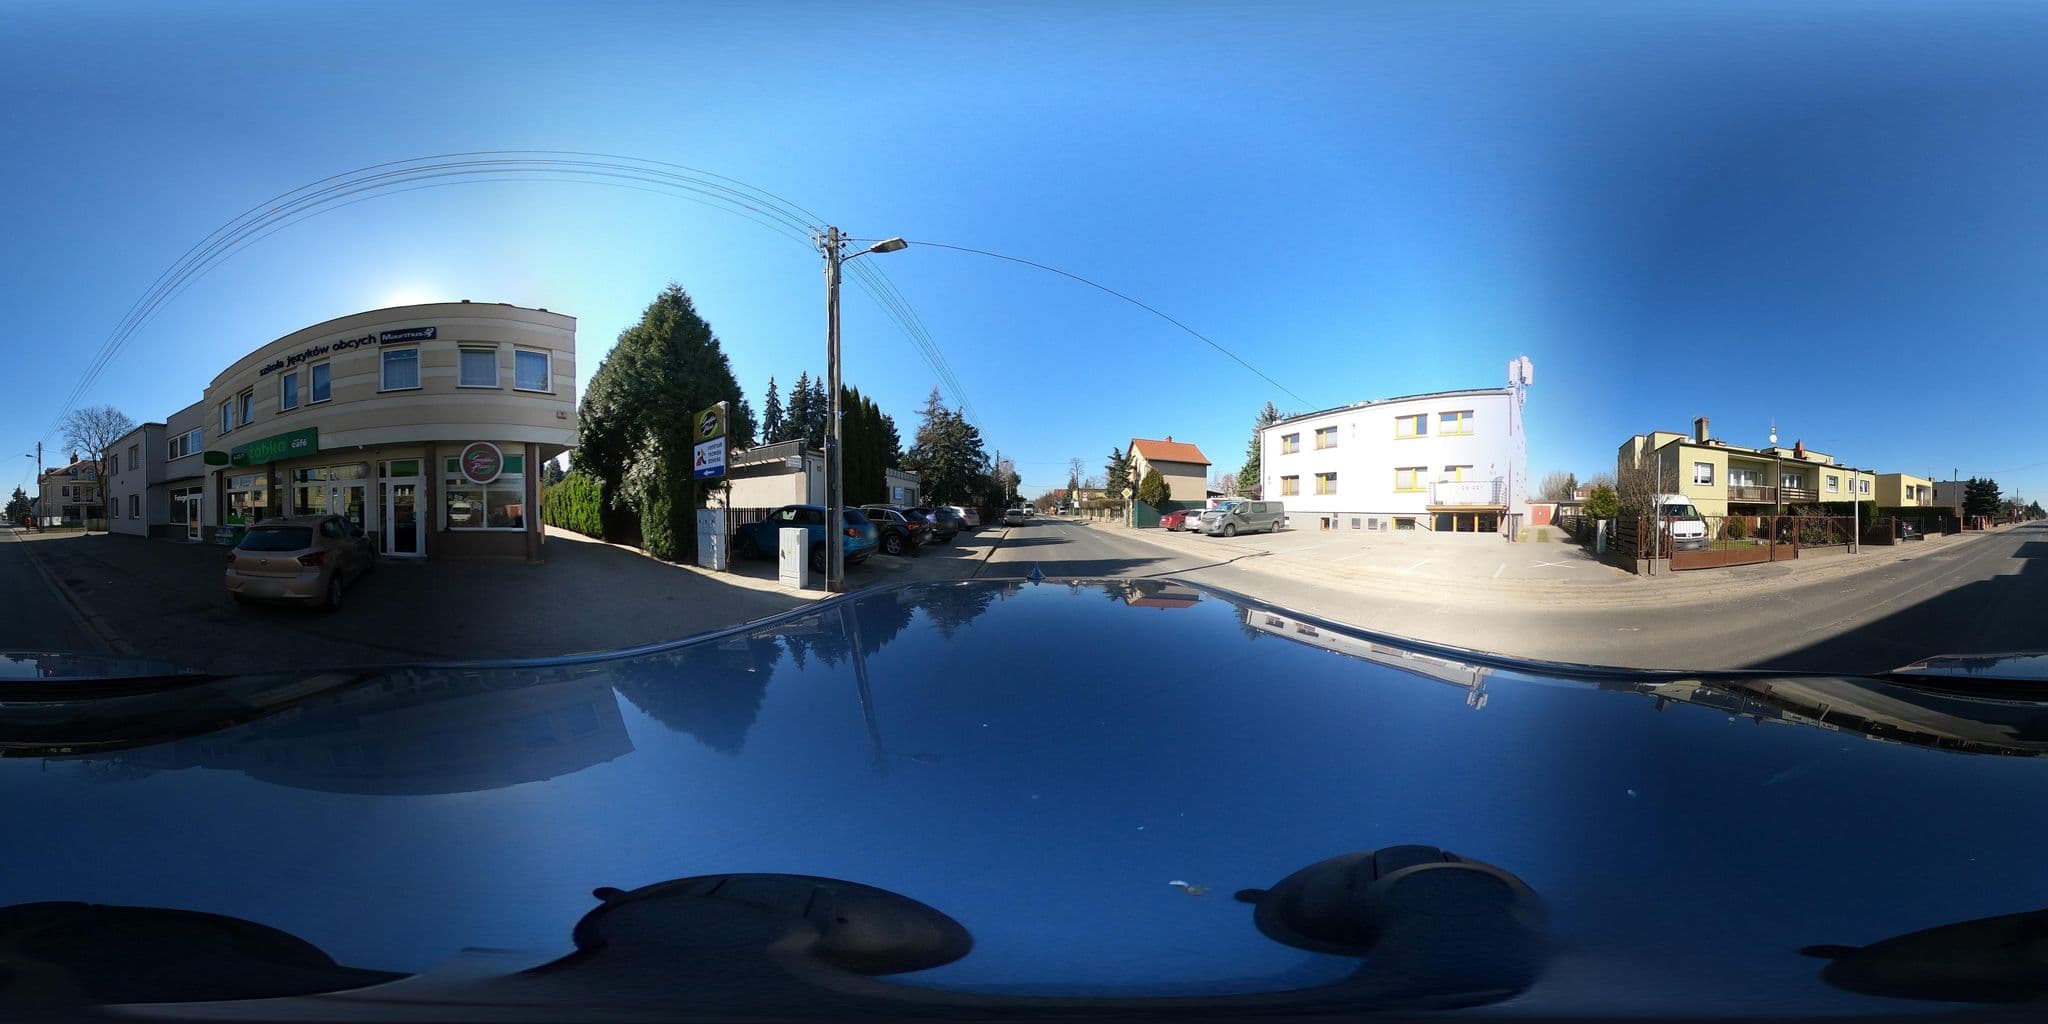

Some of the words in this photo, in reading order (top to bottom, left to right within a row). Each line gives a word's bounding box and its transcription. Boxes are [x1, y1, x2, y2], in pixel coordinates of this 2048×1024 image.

[287, 345, 330, 368] języków
[332, 333, 377, 351] obcych
[291, 439, 308, 449] café
